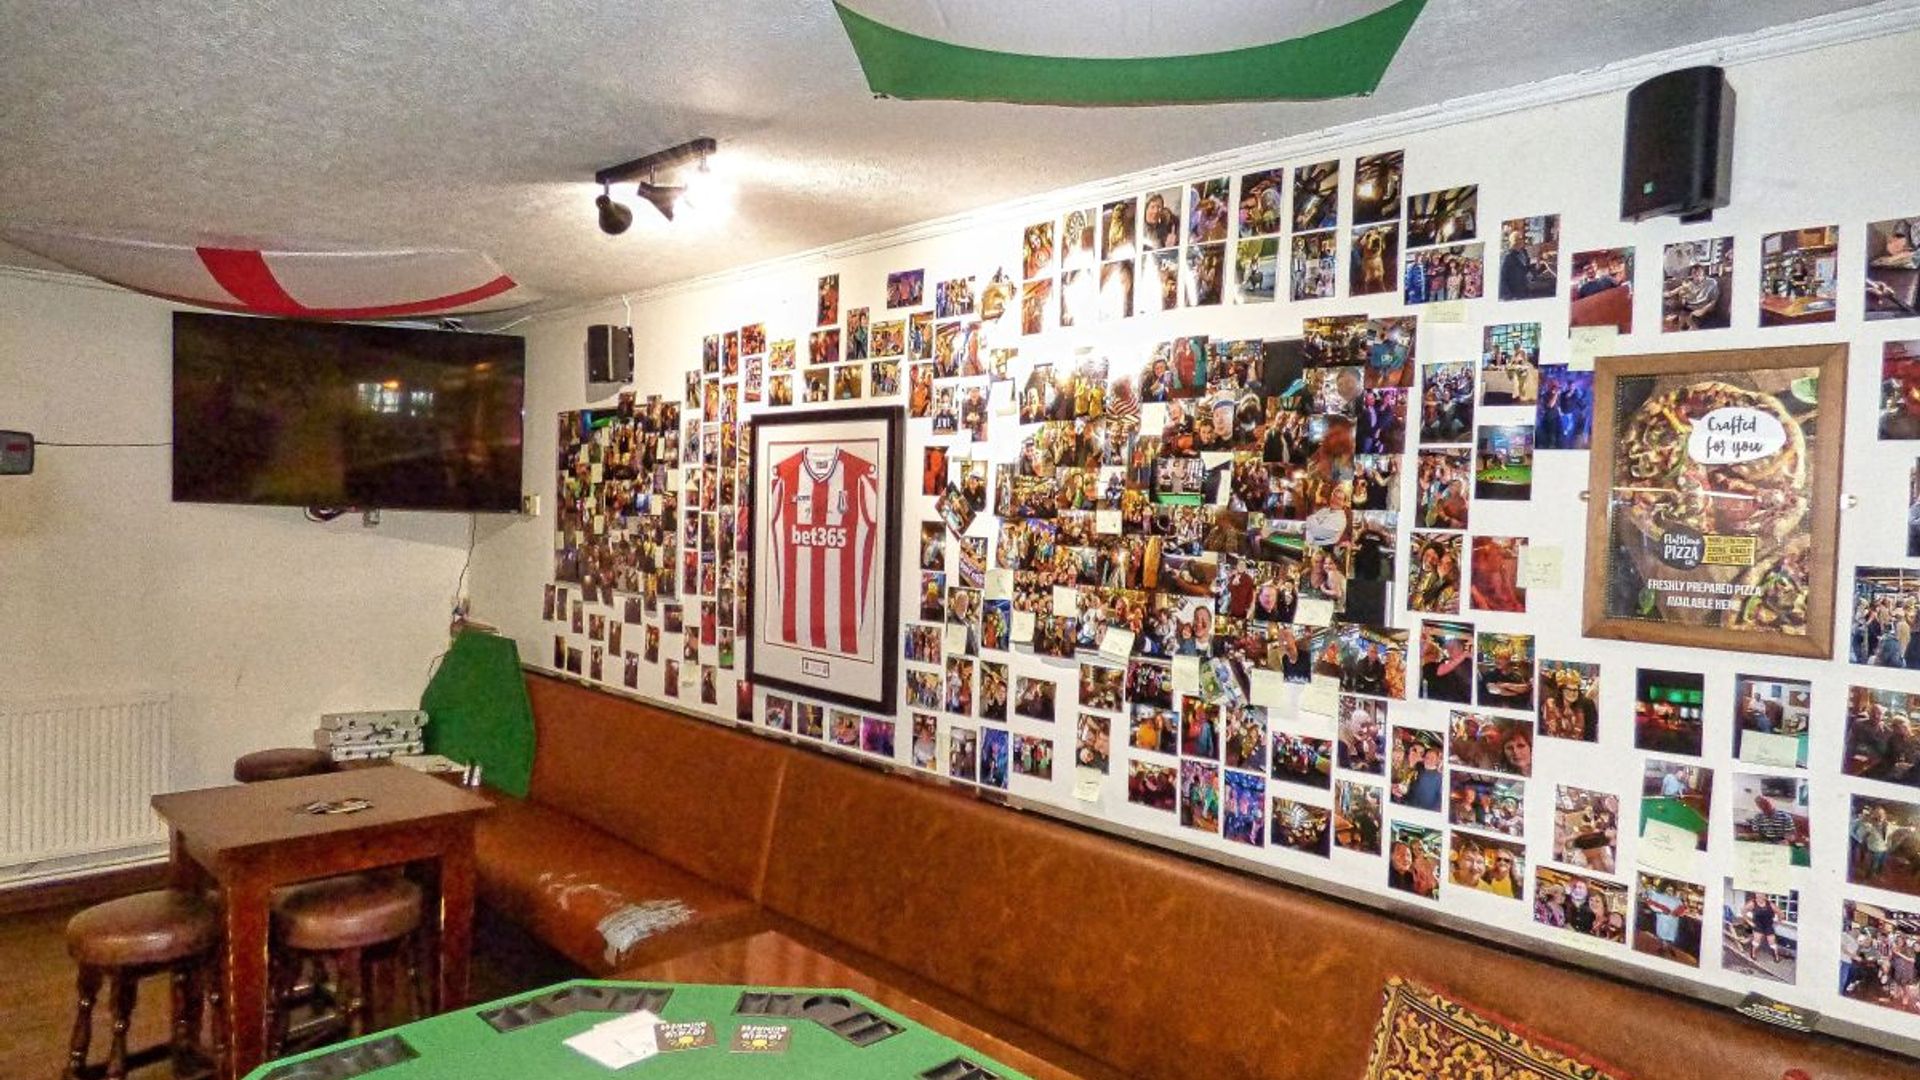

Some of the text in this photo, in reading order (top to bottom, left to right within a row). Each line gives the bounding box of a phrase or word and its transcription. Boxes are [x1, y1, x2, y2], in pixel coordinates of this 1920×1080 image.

[1707, 414, 1756, 435] Crafted
[1707, 436, 1763, 458] for you
[791, 524, 847, 548] bet365
[1664, 545, 1699, 560] PIZZA
[1647, 578, 1762, 597] FRESHLY PREPARED PIZZA
[1666, 595, 1713, 609] AVAILABLE
